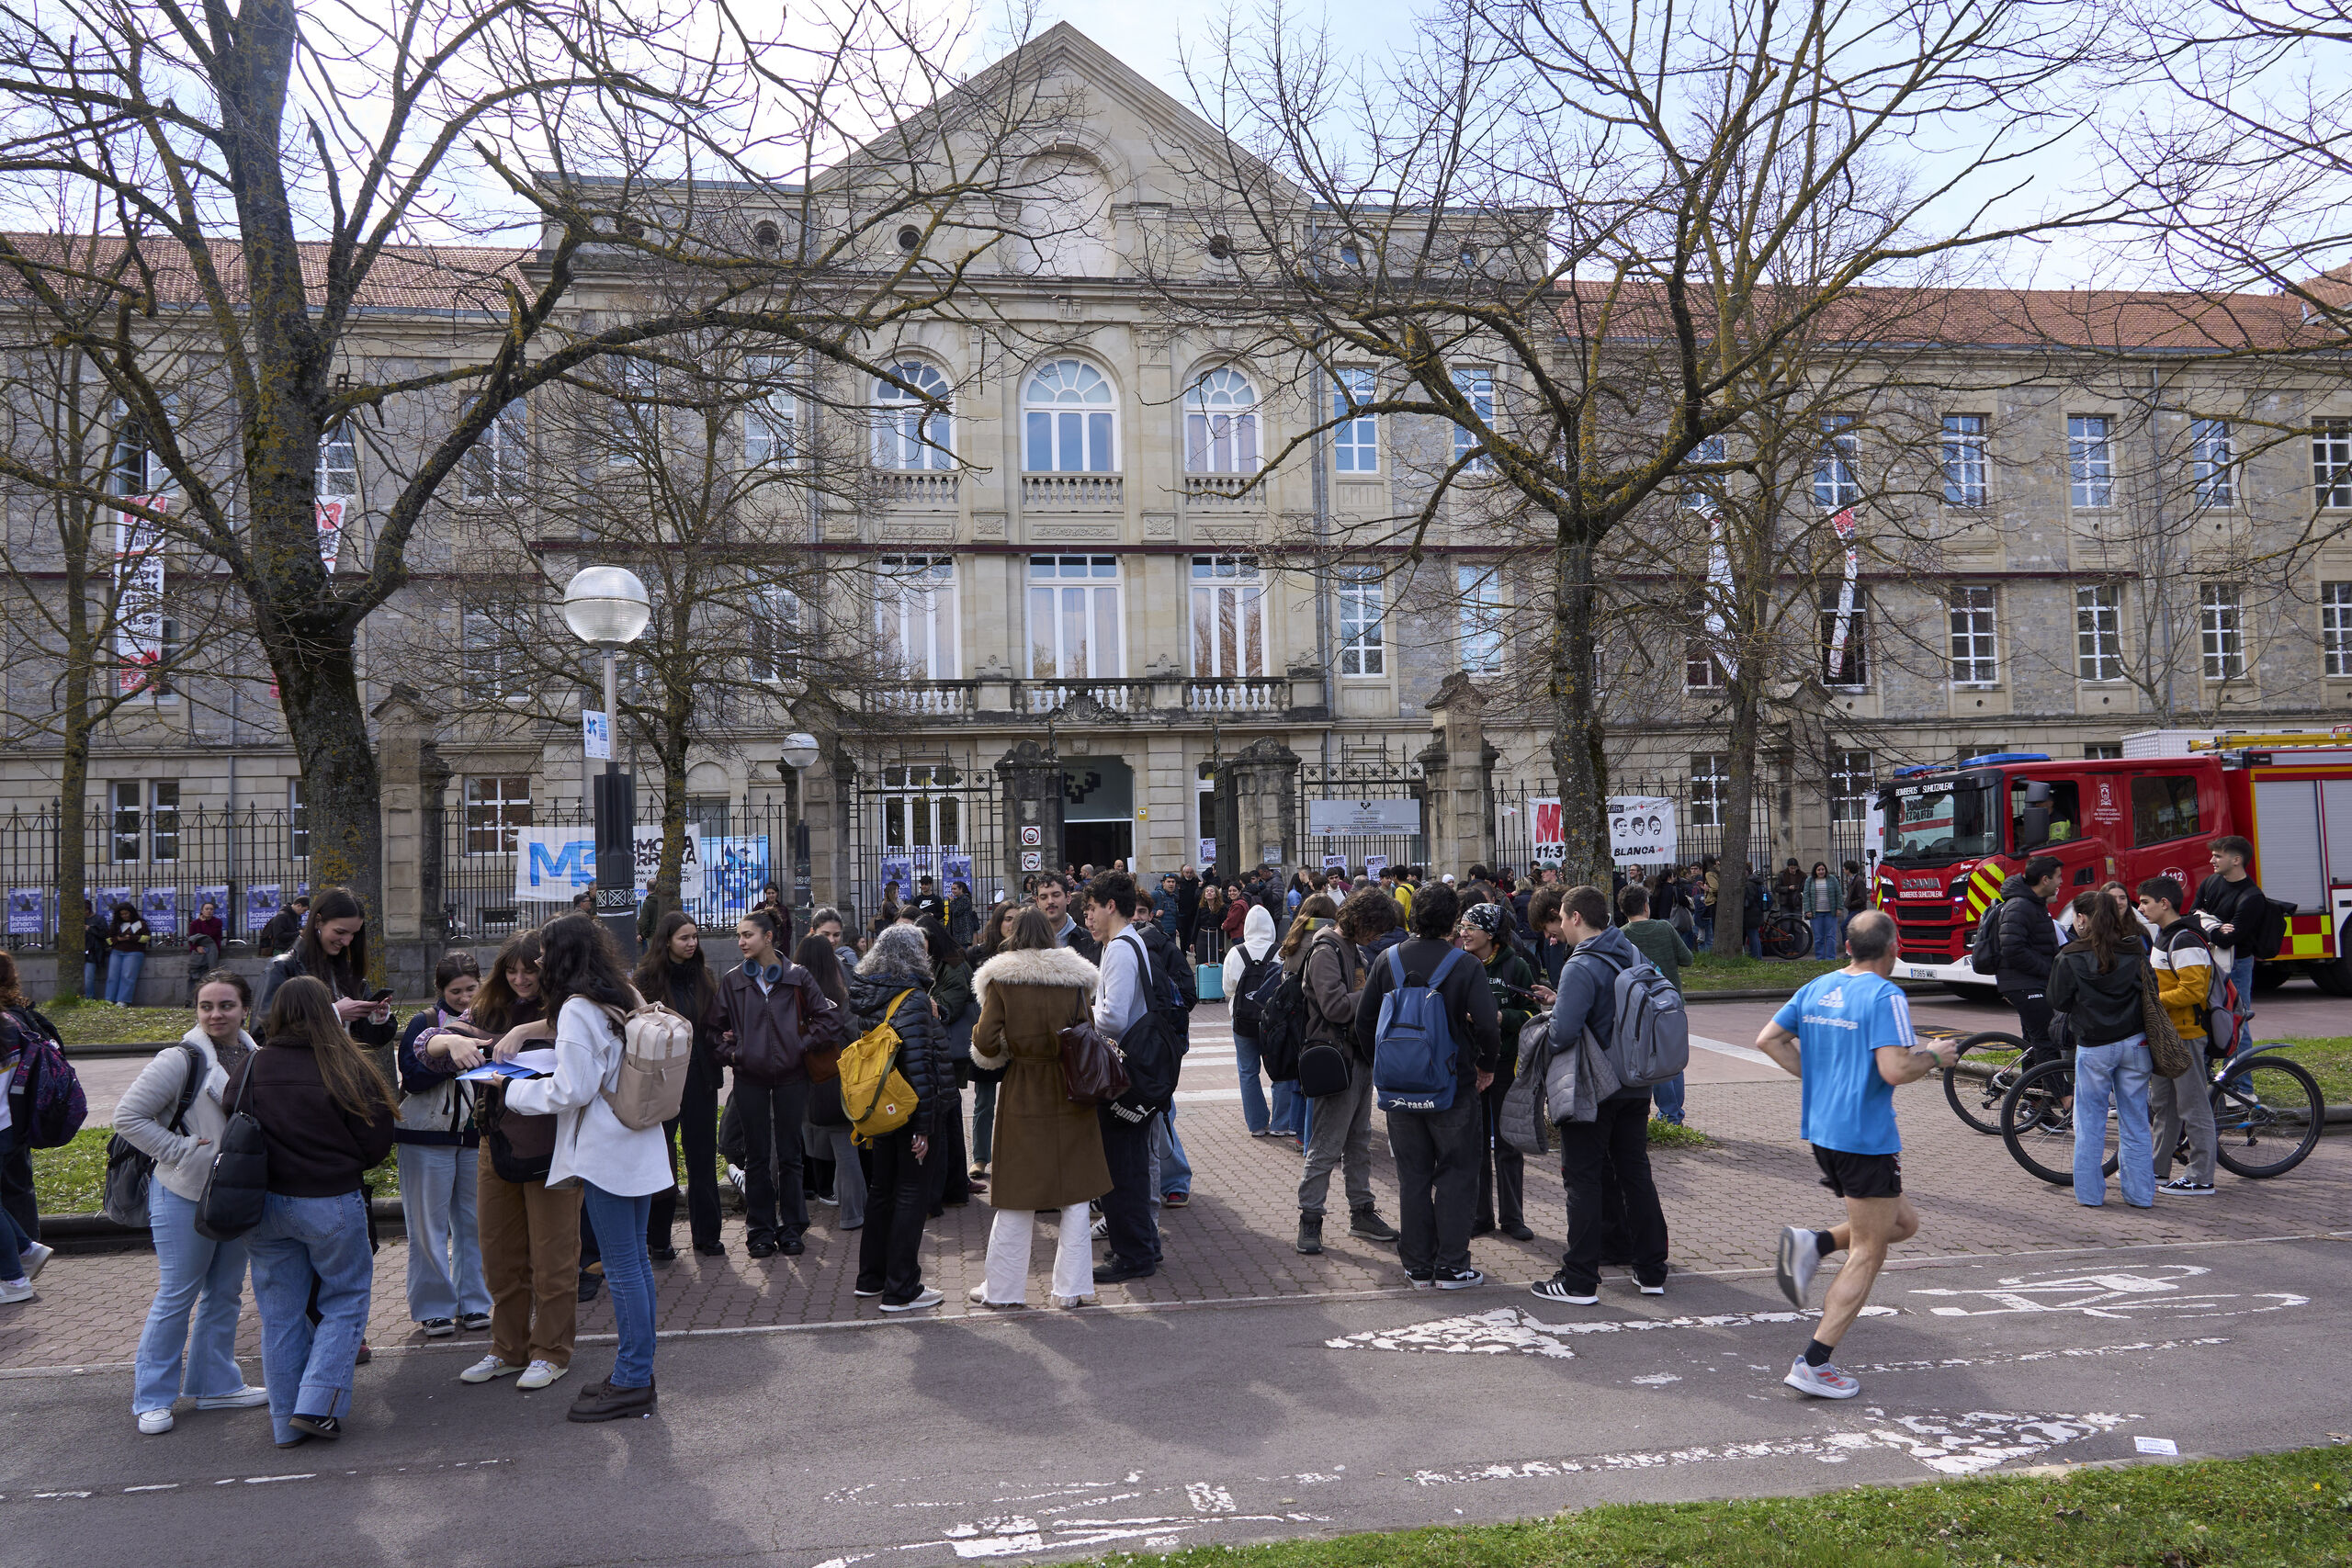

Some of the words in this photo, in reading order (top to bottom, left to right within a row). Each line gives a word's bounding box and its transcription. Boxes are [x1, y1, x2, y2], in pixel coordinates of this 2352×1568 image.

[1895, 786, 1918, 796] BOMBEROS
[1535, 845, 1566, 859] 11:3
[1614, 846, 1656, 857] BLANCA
[1902, 877, 1941, 889] SCANIA
[1817, 998, 1845, 1008] adidas
